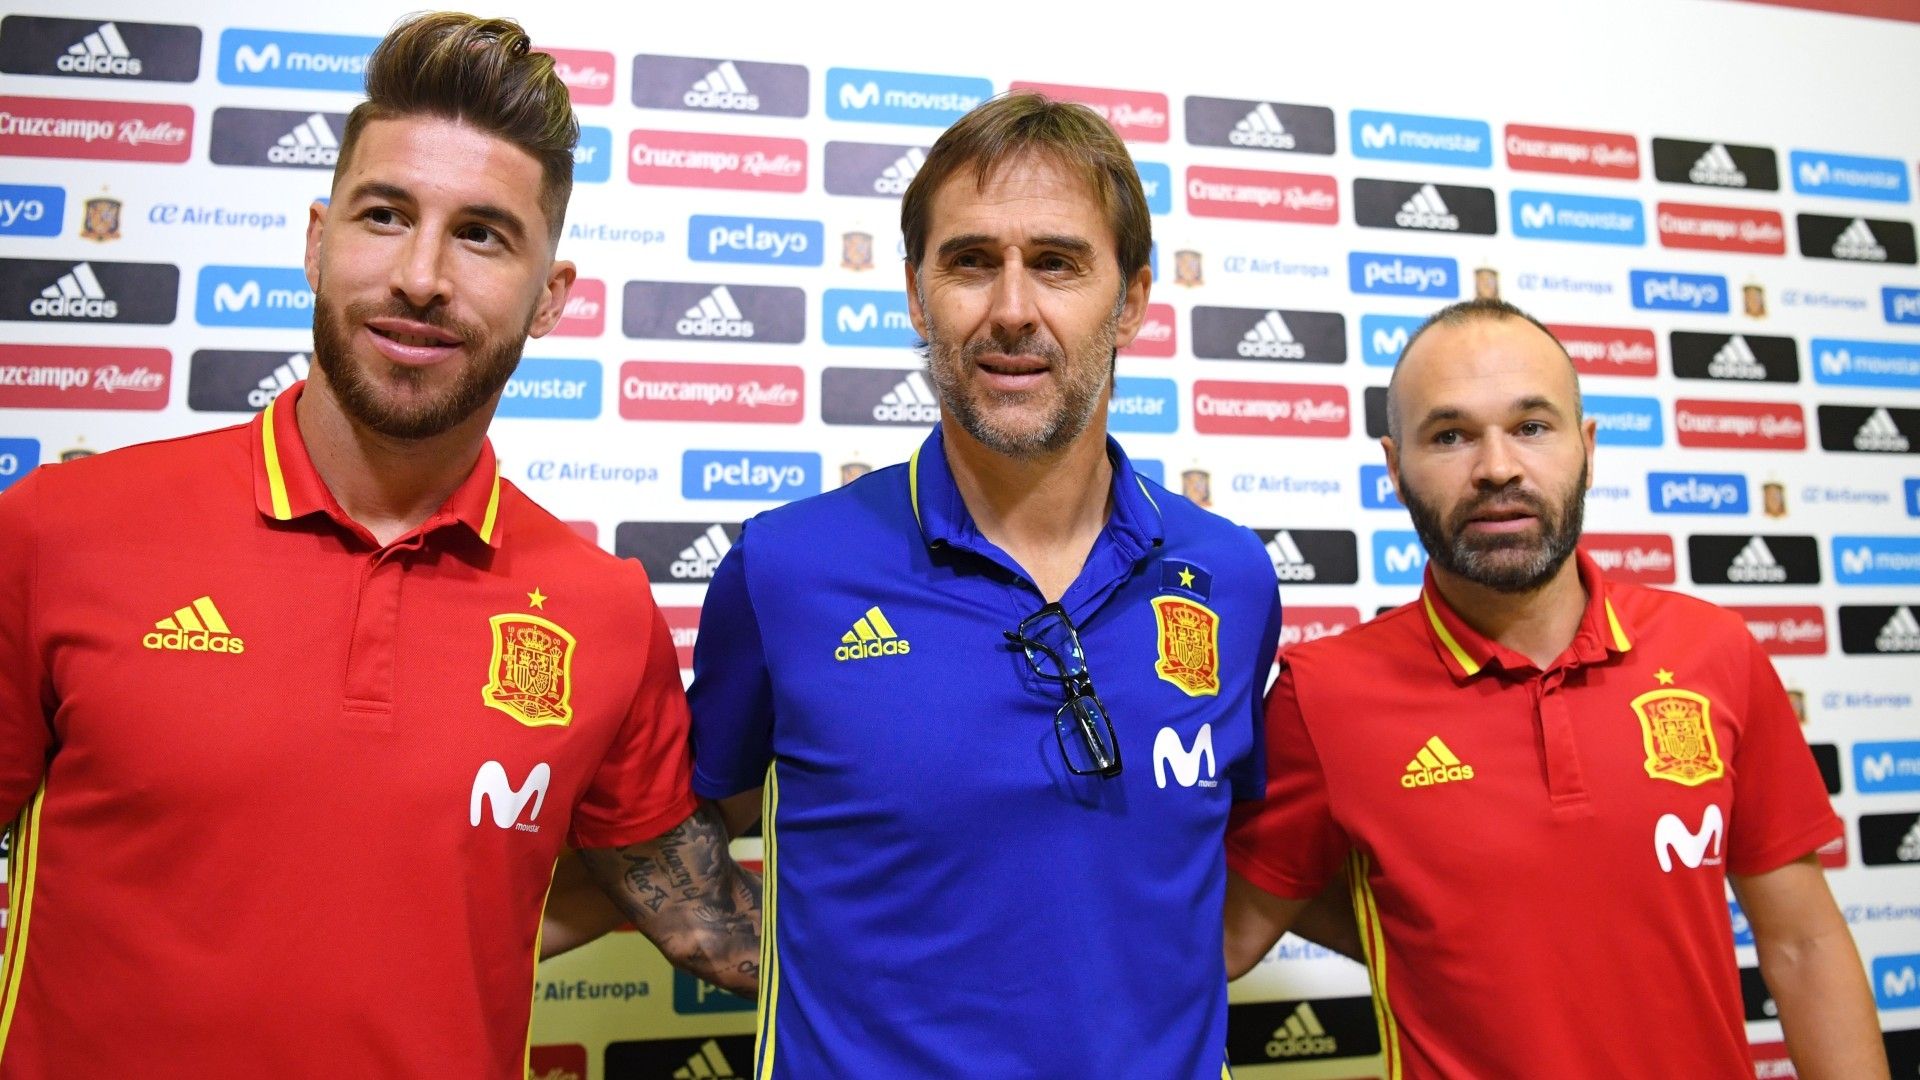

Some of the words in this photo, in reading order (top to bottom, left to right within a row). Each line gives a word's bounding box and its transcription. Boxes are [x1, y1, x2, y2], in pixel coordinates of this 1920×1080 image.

[57, 54, 142, 75] adidas
[286, 51, 368, 74] movis
[684, 91, 759, 111] adidas
[0, 113, 113, 141] Cruzcampo
[1229, 130, 1295, 149] adidas
[1399, 130, 1481, 152] movistar
[267, 146, 342, 165] adida
[632, 143, 740, 172] Cruzcampo
[1188, 179, 1281, 206] Cruzcampo
[182, 209, 287, 229] AirEuropa
[1395, 210, 1460, 230] adidas
[568, 224, 666, 243] AirEuropa
[708, 224, 808, 258] pelayo
[1251, 260, 1330, 277] AirEuropa
[1363, 258, 1447, 292] pelayo
[30, 296, 118, 318] adidas
[676, 313, 754, 338] adidas
[1237, 341, 1305, 359] adidas
[503, 378, 588, 399] ovistar
[624, 377, 733, 405] Cruzcampo
[1110, 397, 1164, 416] vistar
[1196, 394, 1290, 422] Cruzcampo
[559, 461, 658, 483] AirEuropa
[703, 459, 804, 493] pelayo
[1259, 476, 1340, 494] AirEuropa
[142, 628, 244, 654] adidas
[834, 636, 910, 661] adidas
[1401, 764, 1474, 788] adidas
[516, 822, 540, 832] movistar
[545, 980, 648, 1001] AirEuropa
[1265, 1035, 1337, 1058] adidas
